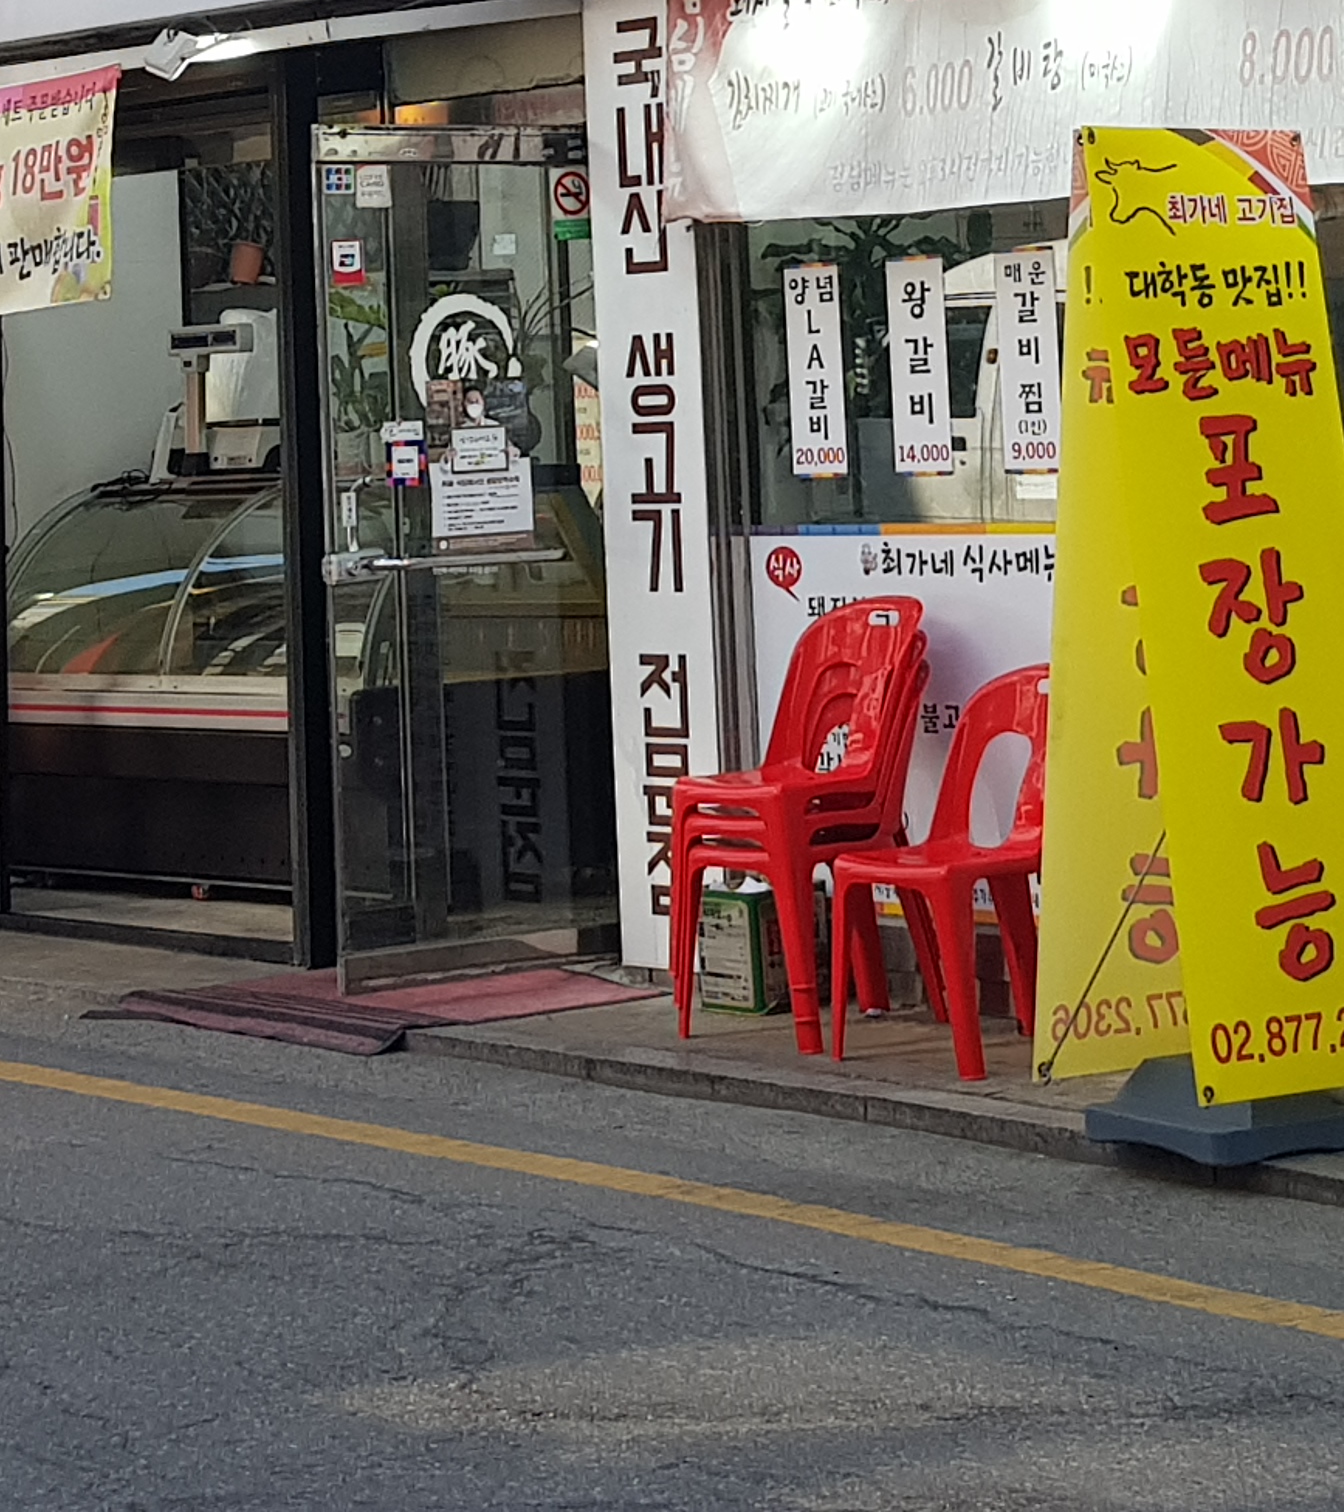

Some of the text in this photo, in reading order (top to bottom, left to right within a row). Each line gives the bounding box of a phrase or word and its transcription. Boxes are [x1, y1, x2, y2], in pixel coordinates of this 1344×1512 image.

[1238, 25, 1335, 88] 8.000
[901, 61, 974, 119] 6.000
[11, 134, 95, 202] 18만원
[1166, 194, 1297, 226] 최가네 고기집
[788, 274, 835, 306] 양념
[1003, 261, 1047, 286] 매운
[1125, 260, 1308, 310] 대학동 맛집!!
[901, 280, 934, 426] 왕갈비
[1013, 290, 1044, 415] 갈비찜
[1123, 326, 1318, 401] 모든메뉴
[1017, 418, 1048, 438] (1인)
[625, 331, 685, 594] 생고기
[795, 446, 846, 468] 20,000
[898, 444, 950, 464] 14,000
[1011, 441, 1058, 462] 9,000
[769, 553, 801, 582] 식사
[880, 541, 955, 578] 최가네
[919, 702, 960, 734] 불고
